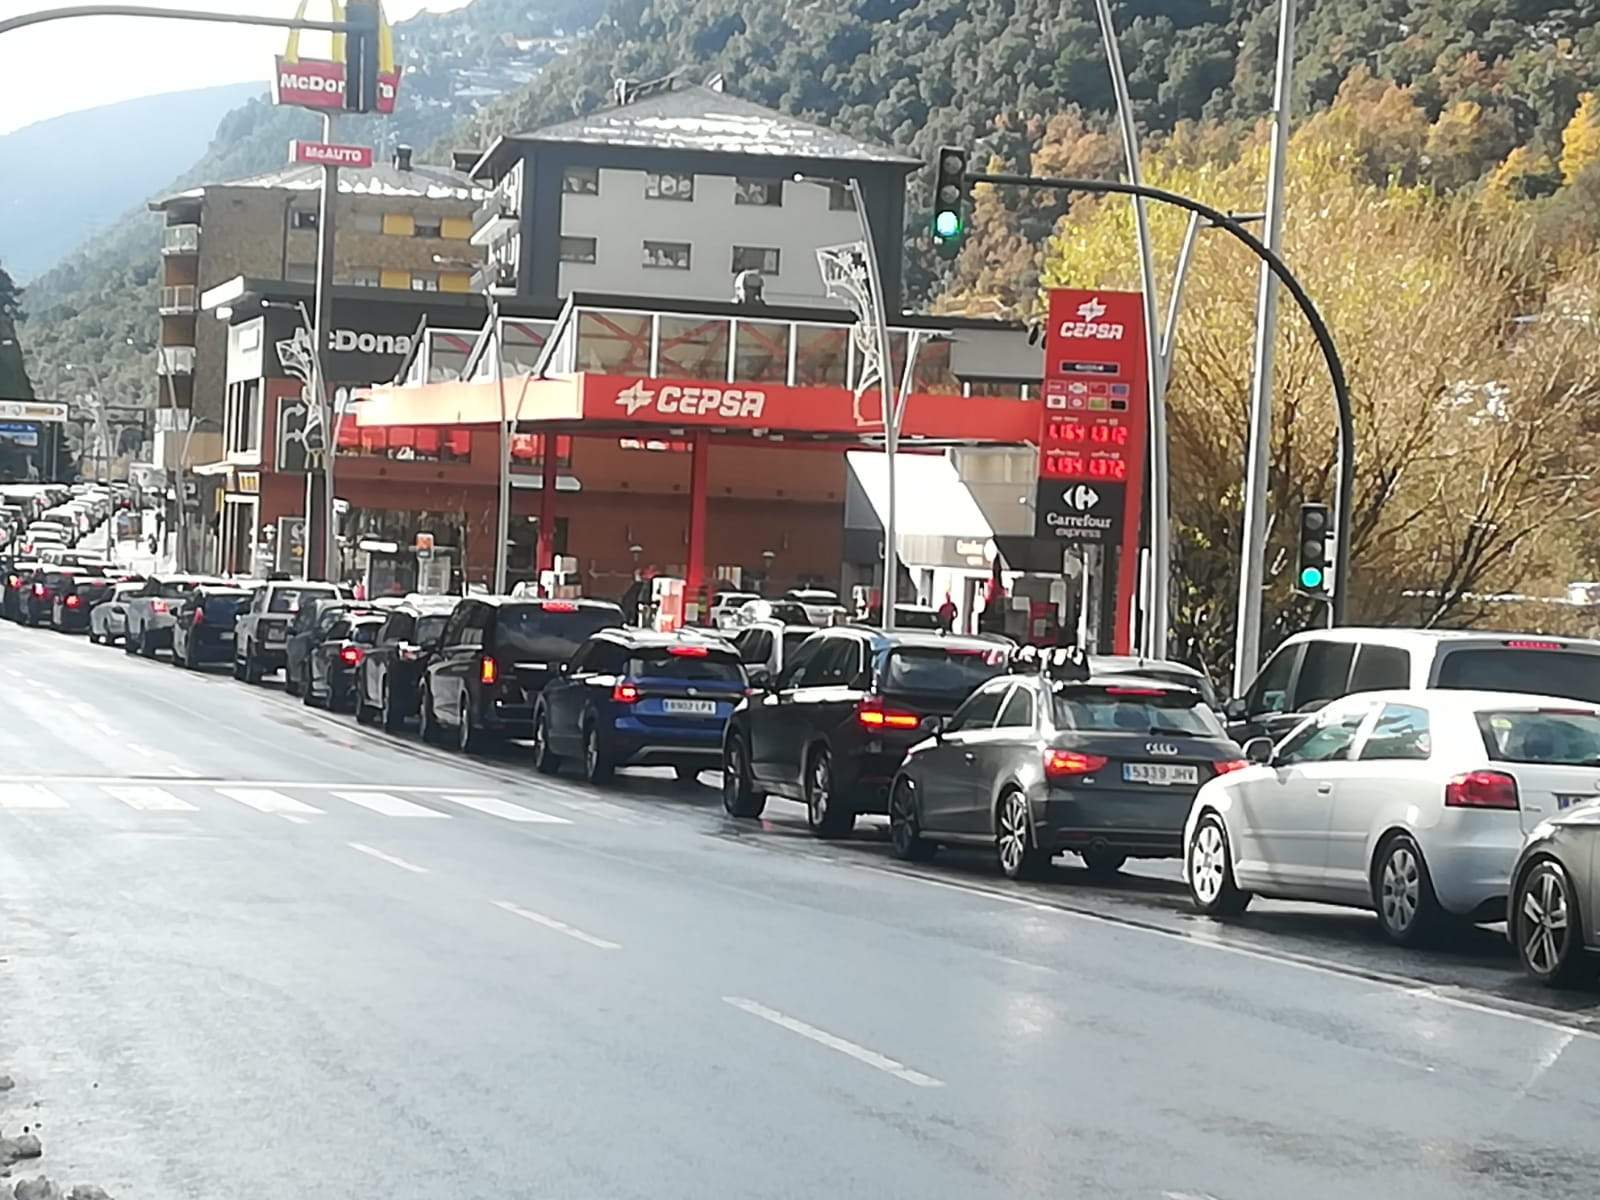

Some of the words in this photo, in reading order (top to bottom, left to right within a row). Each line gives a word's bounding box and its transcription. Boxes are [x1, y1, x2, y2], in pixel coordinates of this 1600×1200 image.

[305, 146, 362, 162] McAUTO
[1060, 321, 1124, 340] CEPSA
[656, 386, 765, 418] CEPSA
[1046, 512, 1112, 528] Carrefour
